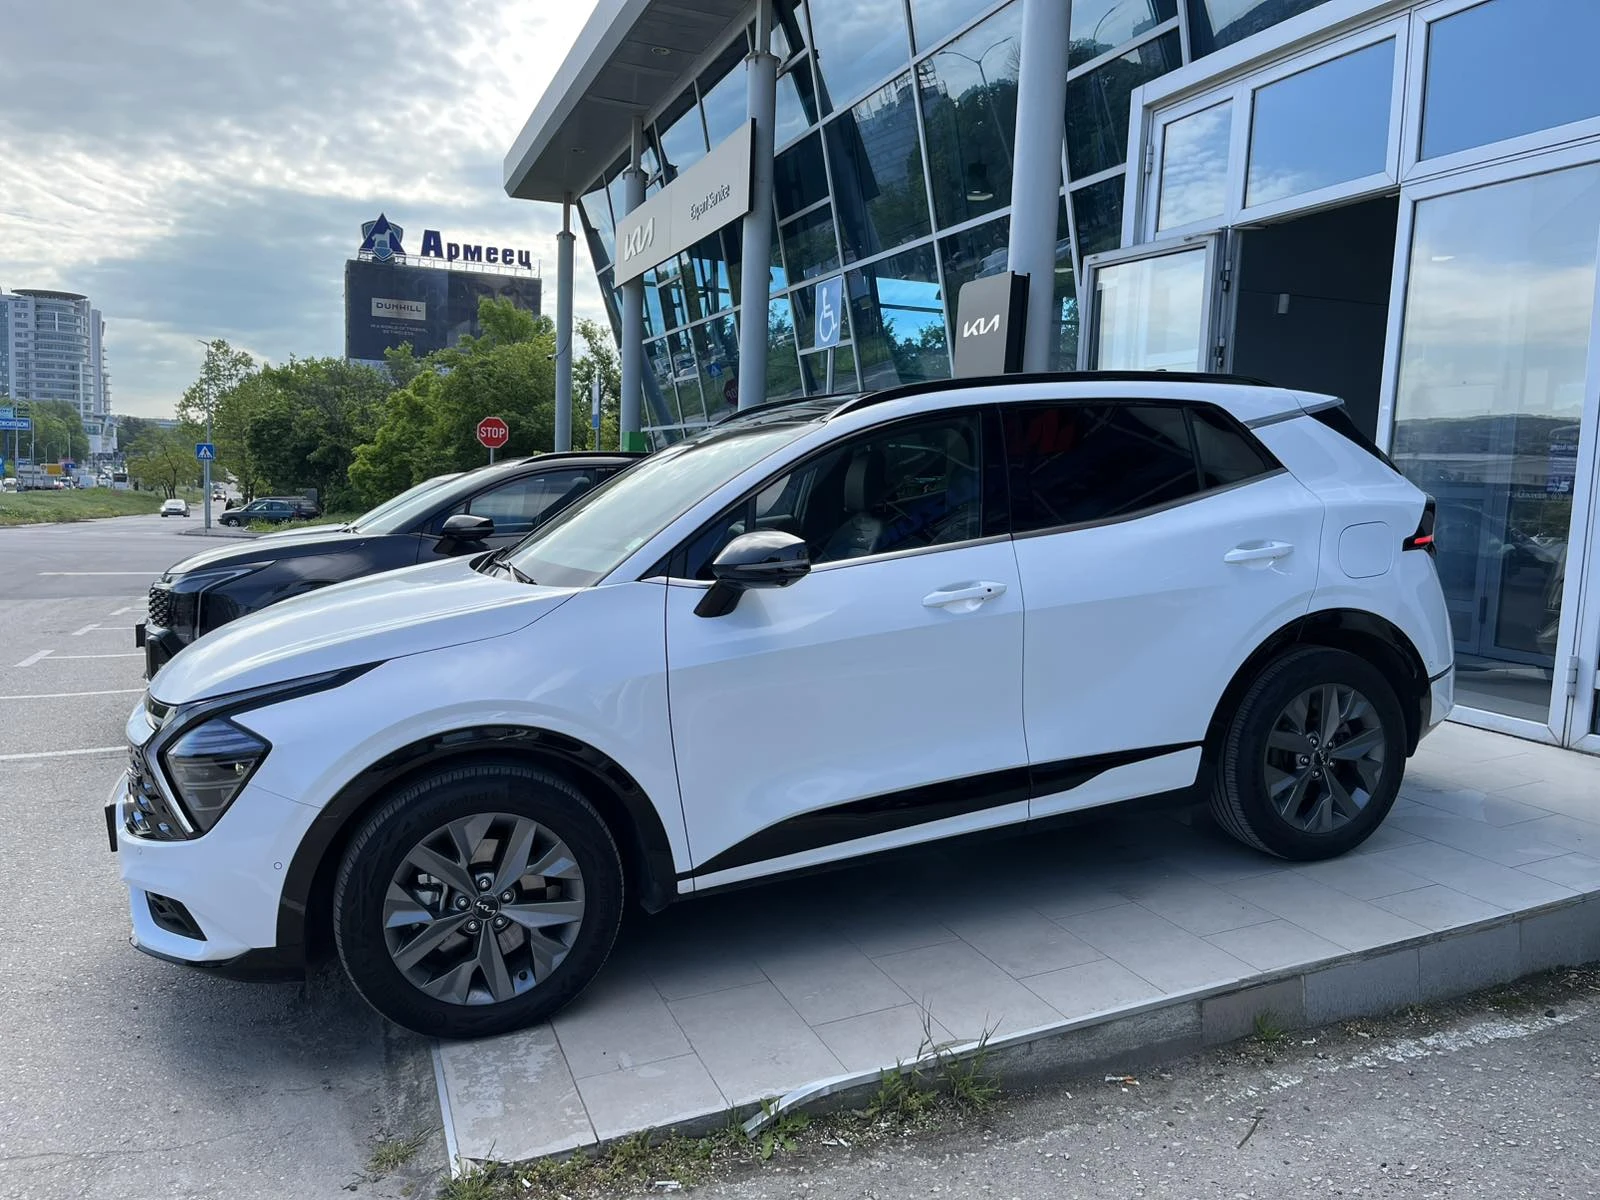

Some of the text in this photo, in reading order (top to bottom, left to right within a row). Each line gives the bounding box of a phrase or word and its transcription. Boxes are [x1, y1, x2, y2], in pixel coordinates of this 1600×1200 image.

[420, 229, 532, 270] Армеец
[623, 217, 655, 262] KIA
[376, 302, 422, 313] DUNHILL
[962, 314, 1000, 338] KIA
[480, 426, 506, 439] STOP
[475, 901, 497, 917] KIA
